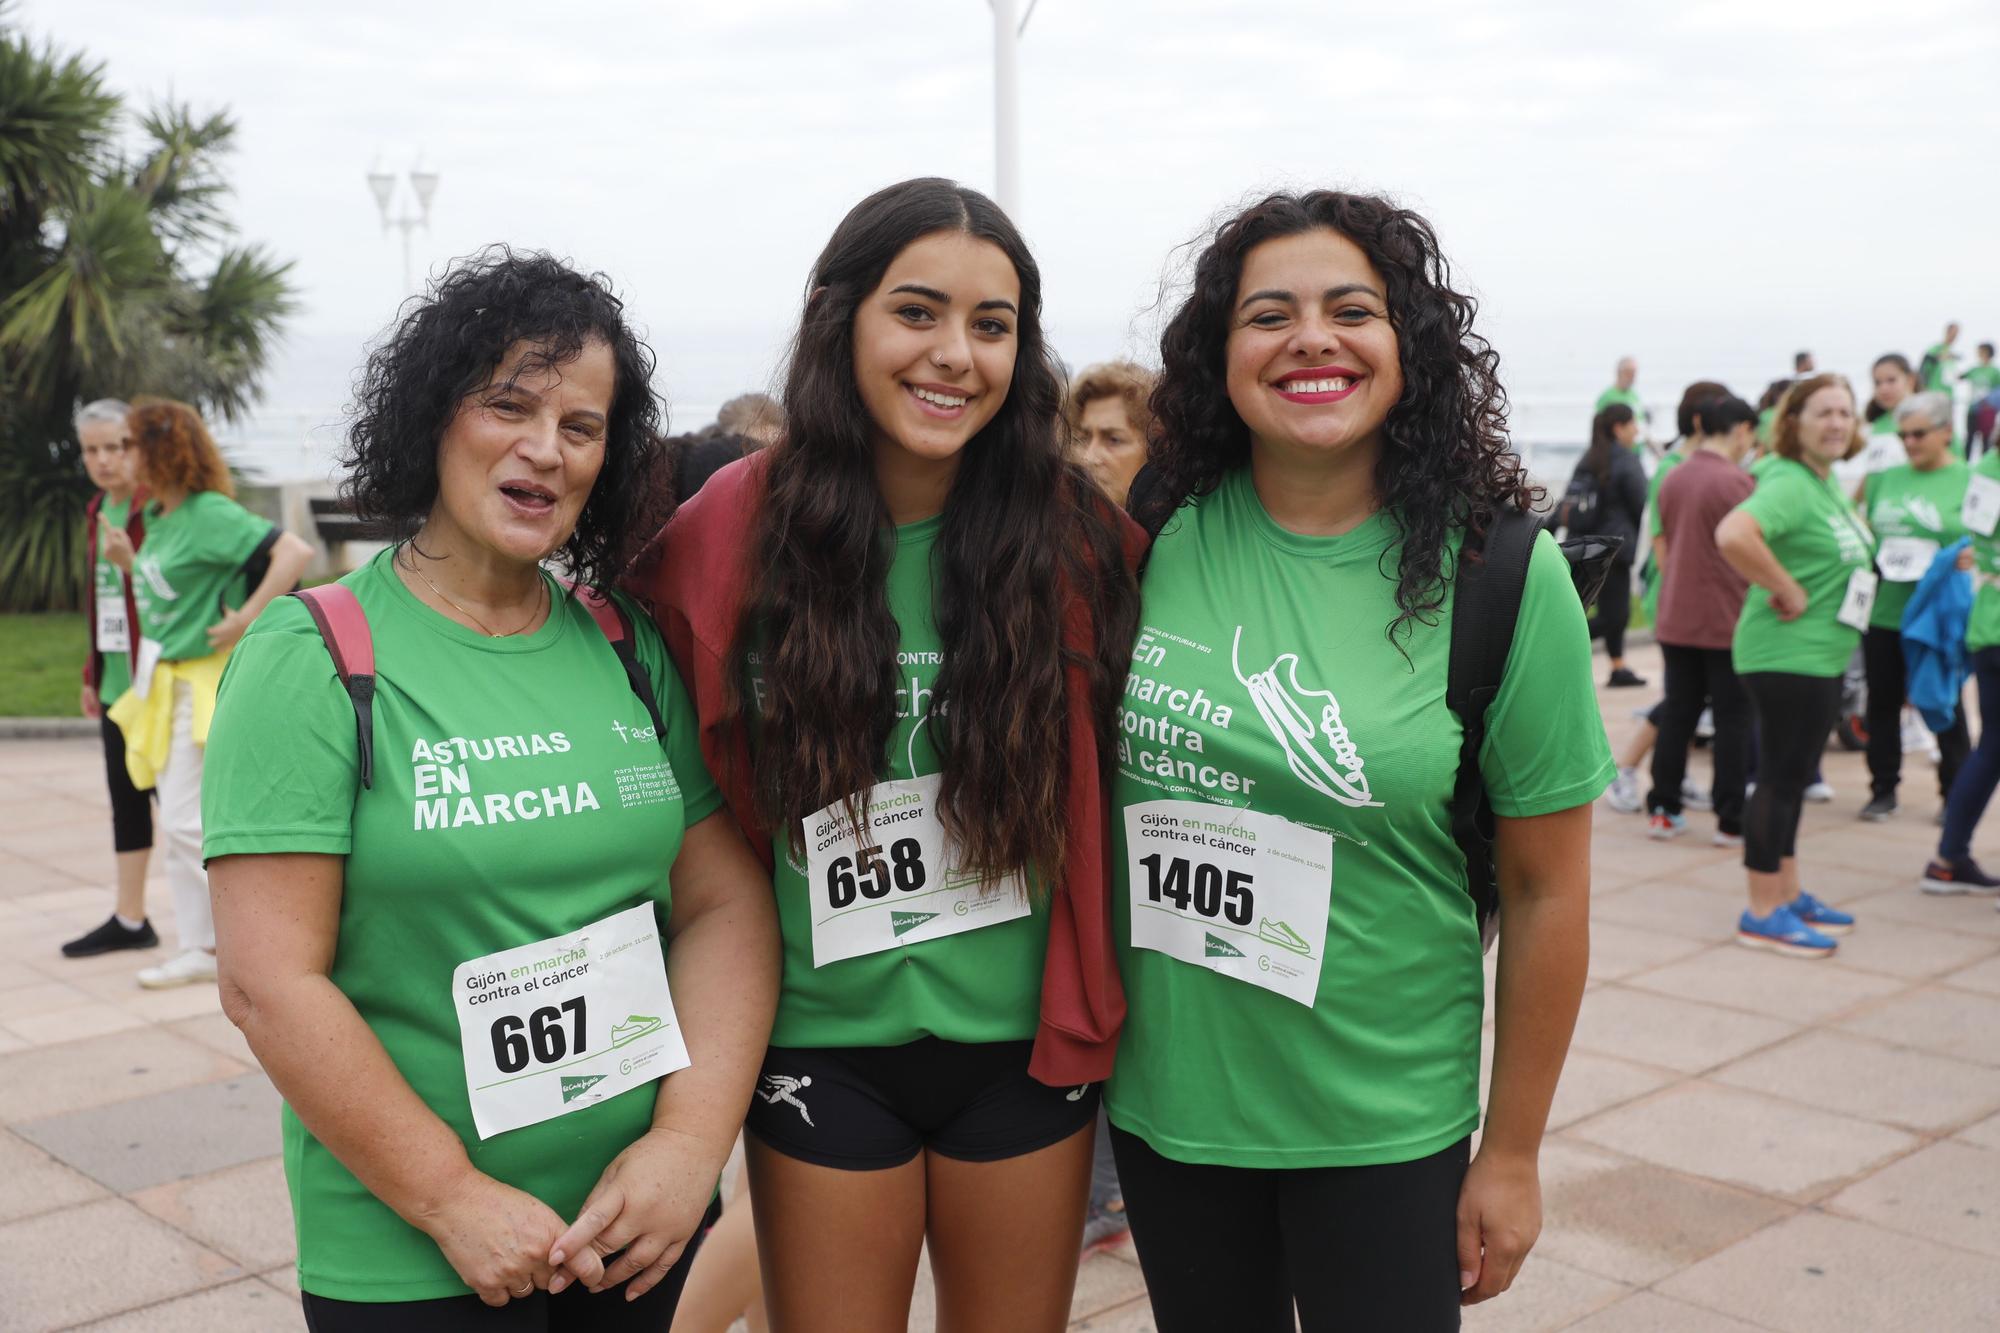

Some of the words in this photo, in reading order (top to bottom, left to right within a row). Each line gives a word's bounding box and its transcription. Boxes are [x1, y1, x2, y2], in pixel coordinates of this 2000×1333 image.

[1132, 634, 1167, 667] En
[1168, 634, 1197, 649] ASTURIAS
[411, 732, 571, 765] ASTURIAS
[414, 763, 471, 797] EN
[615, 774, 635, 785] para
[618, 783, 638, 795] para
[1138, 750, 1256, 795] cáncer
[1170, 785, 1197, 794] CONTRA
[414, 782, 601, 831] MARCHA
[817, 827, 855, 851] contra
[874, 807, 924, 827] cáncer
[1140, 814, 1178, 828] Gijón
[1182, 819, 1200, 830] en
[1204, 822, 1256, 841] marcha
[1142, 828, 1189, 842] contra
[1192, 832, 1205, 846] el
[1209, 837, 1256, 856] cáncer
[827, 838, 926, 909] 658
[1139, 853, 1255, 926] 1405
[466, 970, 507, 991] Gijón
[510, 964, 530, 979] en
[533, 948, 587, 973] marcha
[469, 985, 520, 1005] contra
[524, 977, 539, 992] el
[542, 962, 589, 988] cáncer
[491, 995, 587, 1074] 667
